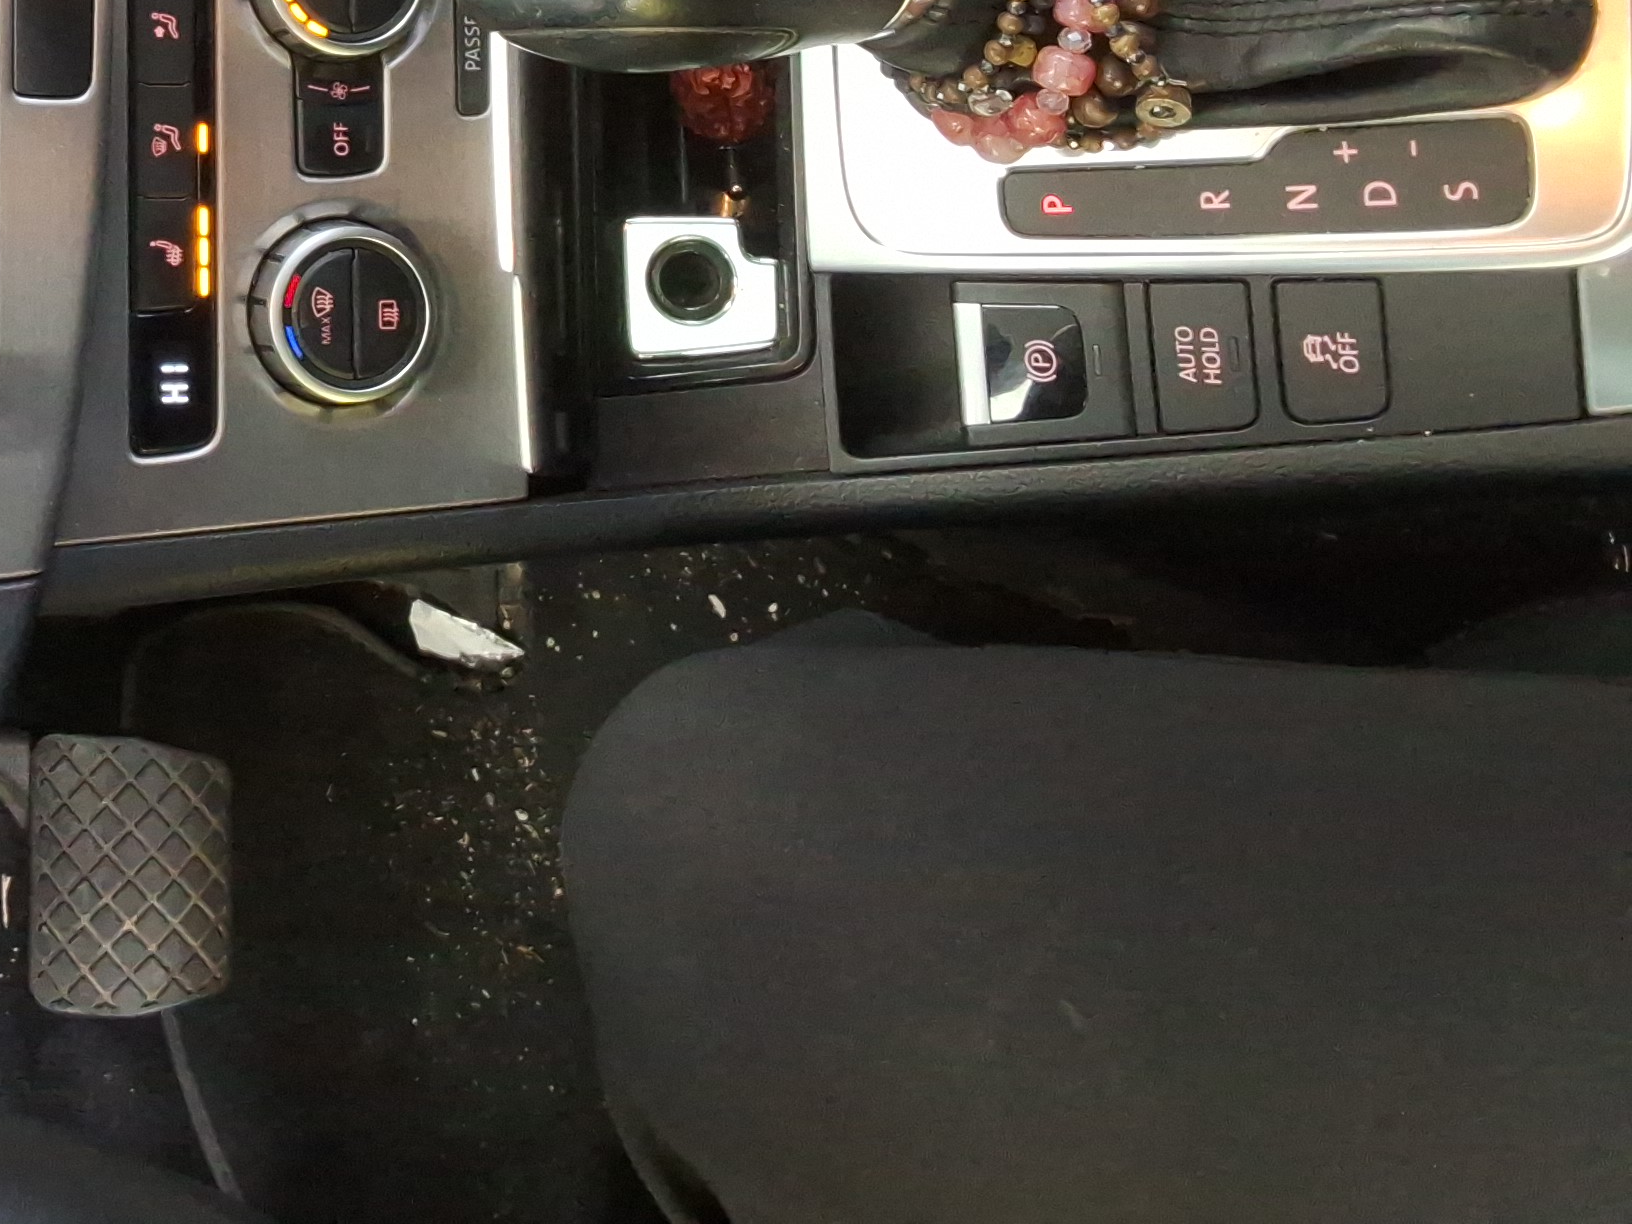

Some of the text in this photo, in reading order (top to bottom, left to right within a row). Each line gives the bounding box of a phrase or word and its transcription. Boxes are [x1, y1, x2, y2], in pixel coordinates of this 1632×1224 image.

[332, 122, 350, 157] OFF
[1199, 190, 1231, 210] R
[1285, 184, 1319, 211] N
[1363, 180, 1398, 207] D
[1443, 180, 1479, 202] S
[1041, 194, 1074, 216] P
[320, 317, 331, 344] MAX
[1174, 325, 1198, 383] AUTO
[1199, 326, 1222, 385] HOLD
[1334, 331, 1360, 374] OFF
[159, 362, 190, 405] HI
